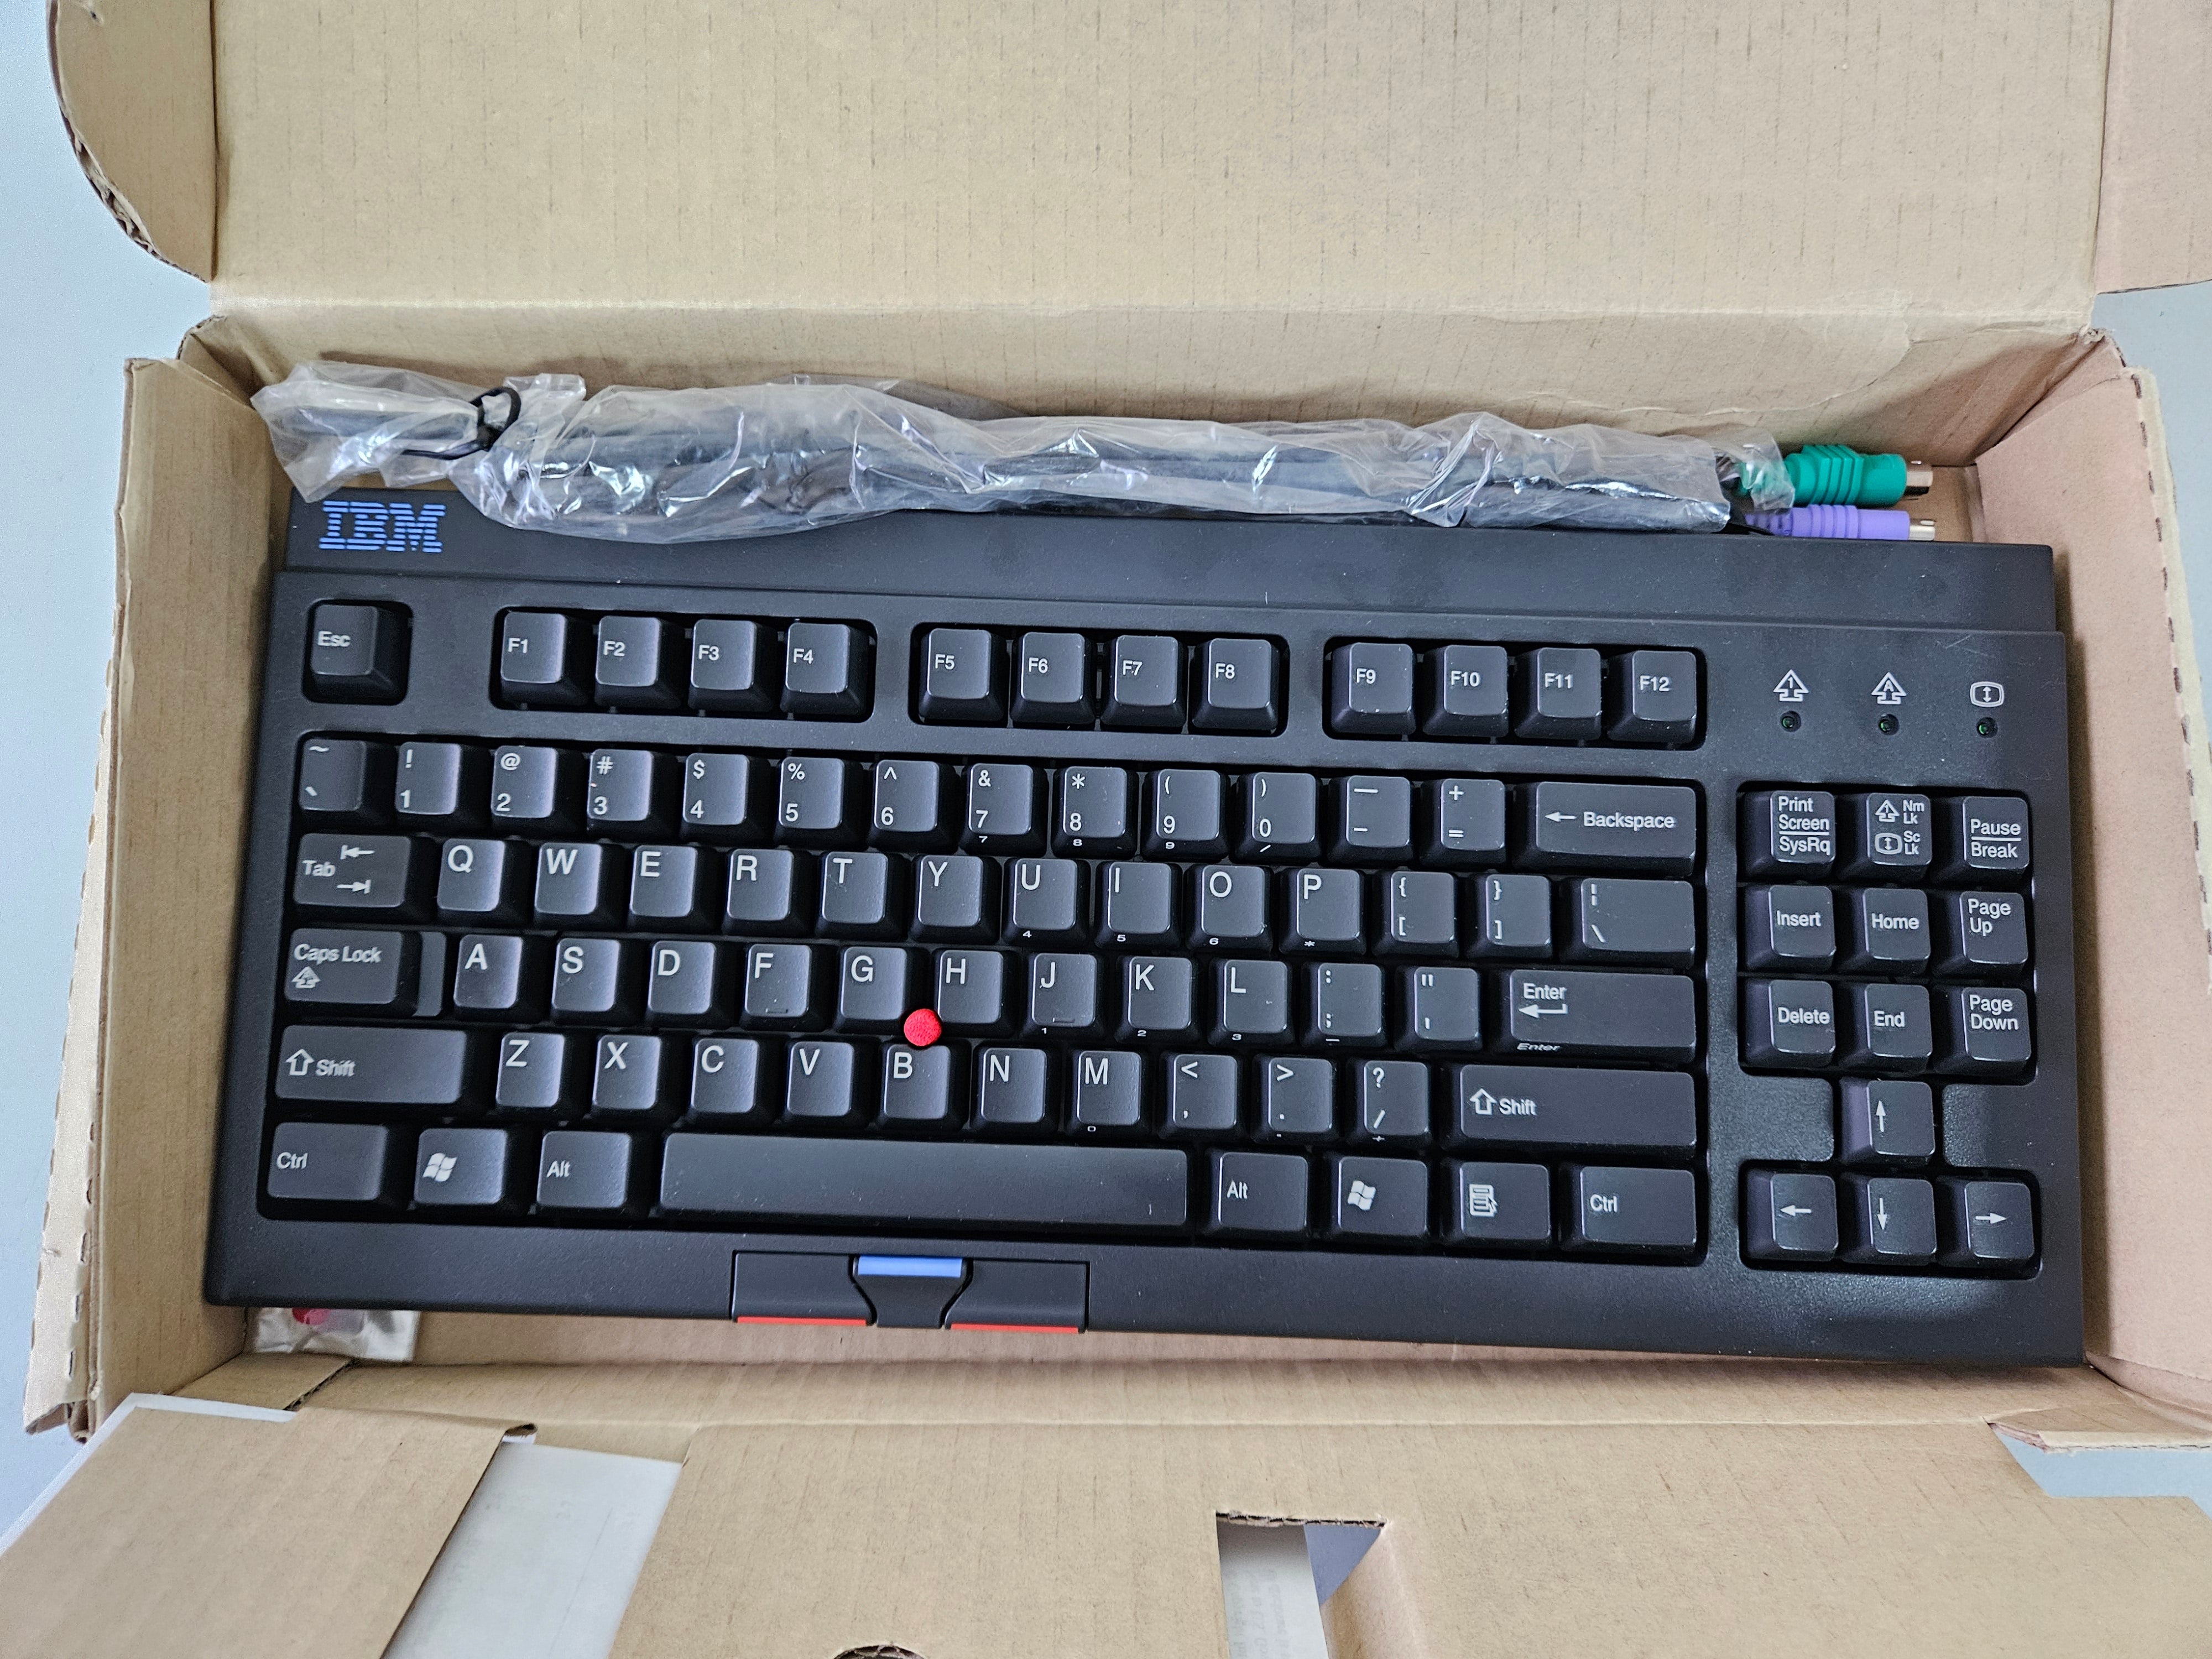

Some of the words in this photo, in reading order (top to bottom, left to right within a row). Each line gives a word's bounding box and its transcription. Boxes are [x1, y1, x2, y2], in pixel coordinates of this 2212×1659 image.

[319, 500, 446, 553] IBM
[317, 630, 351, 647] Esc
[508, 637, 528, 654] F1
[603, 640, 625, 656] F2
[698, 644, 719, 661] F3
[793, 648, 814, 664] F4
[935, 654, 955, 670] F5
[1029, 657, 1048, 674] F6
[1123, 660, 1142, 676] F7
[1215, 663, 1235, 679] F8
[1357, 668, 1376, 684] F9
[1451, 670, 1480, 687] F10
[1545, 672, 1573, 689] F11
[1640, 675, 1670, 691] F12
[405, 749, 413, 768] !
[500, 753, 520, 770] @
[596, 756, 613, 775] #
[693, 759, 705, 779] $
[787, 763, 805, 780] %
[884, 766, 897, 780] ^
[978, 769, 991, 787] &
[1165, 776, 1170, 795] (
[1261, 779, 1266, 797] )
[1448, 785, 1464, 801] +
[400, 790, 410, 808] 1
[495, 793, 511, 812] 2
[593, 796, 608, 815] 3
[1778, 796, 1814, 812] Print
[1903, 800, 1925, 812] Nm
[690, 800, 704, 818] 4
[785, 803, 799, 822] 5
[881, 806, 894, 826] 6
[1903, 812, 1918, 825] Lk
[975, 810, 988, 828] 7
[1070, 812, 1082, 831] 8
[1164, 815, 1176, 834] 9
[1259, 818, 1271, 837] 0
[1584, 811, 1675, 831] Backspace
[1778, 813, 1830, 831] Screen
[1970, 818, 2021, 836] Pause
[1073, 838, 1083, 847] 8
[1448, 830, 1464, 838] =
[1903, 830, 1921, 843] Sc
[1779, 836, 1831, 855] SysRq
[1905, 843, 1919, 855] Lk
[1971, 842, 2018, 858] Break
[302, 860, 336, 877] Tab
[447, 845, 473, 873] Q
[546, 848, 578, 875] W
[640, 851, 661, 877] E
[736, 855, 758, 881] R
[833, 858, 853, 884] T
[928, 861, 948, 886] Y
[1021, 863, 1041, 890] U
[1115, 867, 1120, 893] I
[1209, 871, 1232, 898] O
[1303, 874, 1322, 900] P
[1399, 877, 1406, 898] {
[1493, 880, 1503, 900] }
[1968, 898, 2011, 919] Page
[1399, 916, 1406, 936] [
[1776, 910, 1822, 927] Insert
[1871, 913, 1919, 930] Home
[1970, 917, 1993, 937] Up
[1494, 920, 1503, 940] ]
[1591, 924, 1606, 943] \
[294, 943, 340, 965] Caps
[342, 946, 382, 963] Lock
[465, 943, 488, 970] A
[562, 946, 584, 974] S
[658, 950, 681, 976] D
[754, 952, 774, 979] F
[851, 955, 873, 982] G
[946, 957, 966, 984] H
[1040, 962, 1056, 988] J
[1135, 964, 1154, 991] K
[1230, 967, 1246, 994] L
[1326, 970, 1331, 983] :
[1523, 983, 1567, 1000] Enter
[1969, 994, 2013, 1015] Page
[1326, 1013, 1332, 1028] ;
[1777, 1007, 1830, 1024] Delete
[1874, 1010, 1905, 1027] End
[1970, 1013, 2019, 1030] Down
[505, 1039, 530, 1067] Z
[604, 1041, 628, 1070] X
[1517, 1042, 1561, 1051] Enter
[315, 1059, 356, 1077] Shift
[701, 1045, 724, 1073] C
[799, 1048, 821, 1076] V
[893, 1052, 912, 1079] B
[989, 1055, 1010, 1082] N
[1085, 1057, 1108, 1085] M
[1181, 1061, 1198, 1078] <
[1277, 1064, 1294, 1081] >
[1373, 1067, 1385, 1088] ?
[1499, 1098, 1537, 1115] Shift
[1373, 1109, 1386, 1129] /
[276, 1152, 308, 1169] Ctrl
[546, 1160, 571, 1177] Alt
[1227, 1181, 1248, 1199] Alt
[1590, 1194, 1618, 1212] Ctrl
